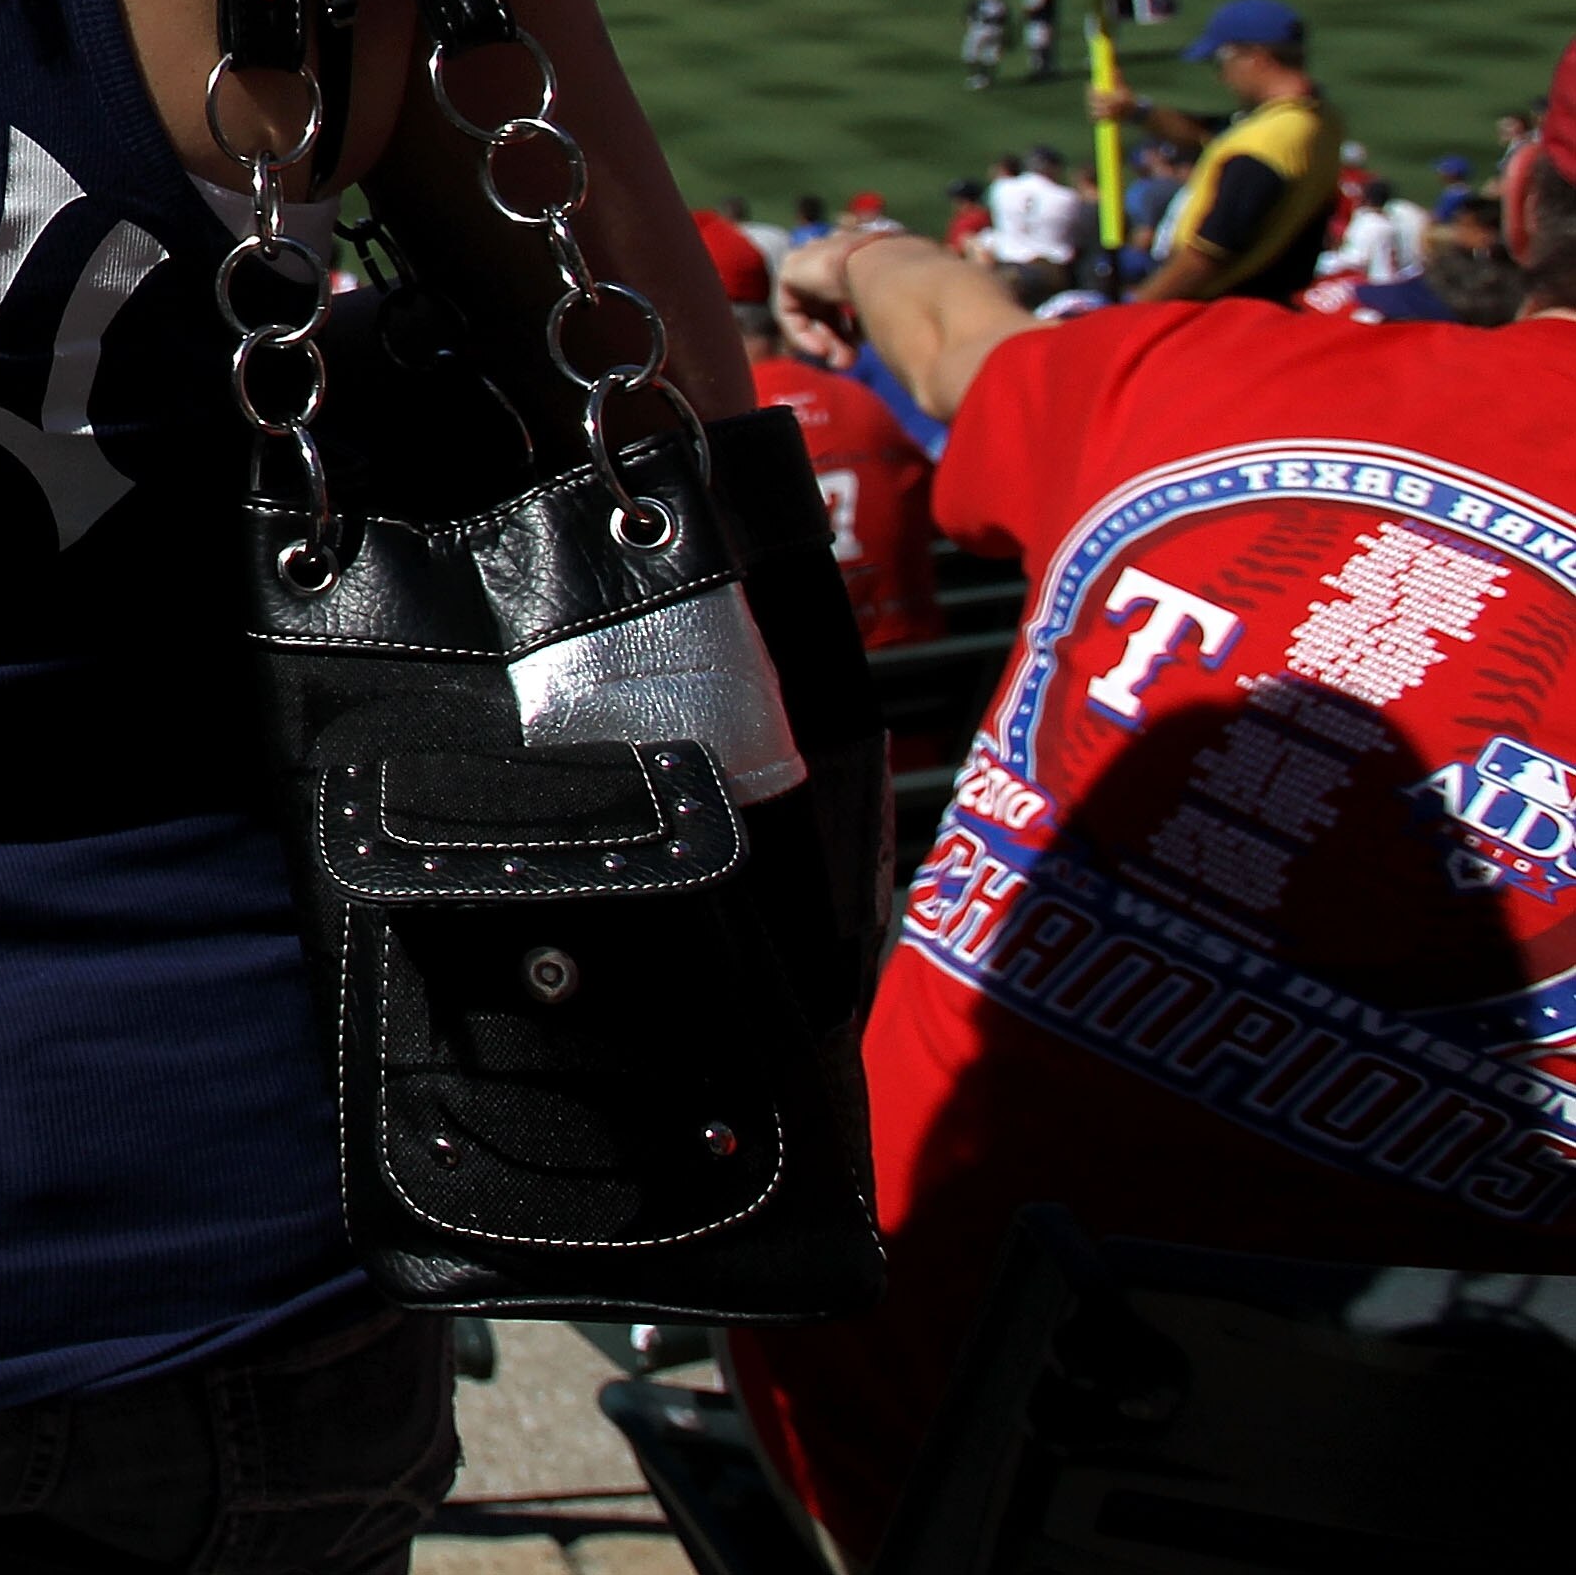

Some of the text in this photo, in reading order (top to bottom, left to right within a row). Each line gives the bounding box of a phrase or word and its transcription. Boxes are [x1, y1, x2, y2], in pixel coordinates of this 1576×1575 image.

[1239, 460, 1434, 507] TEXAS
[1087, 565, 1243, 726] T
[902, 824, 1576, 1222] CHAMPIONS
